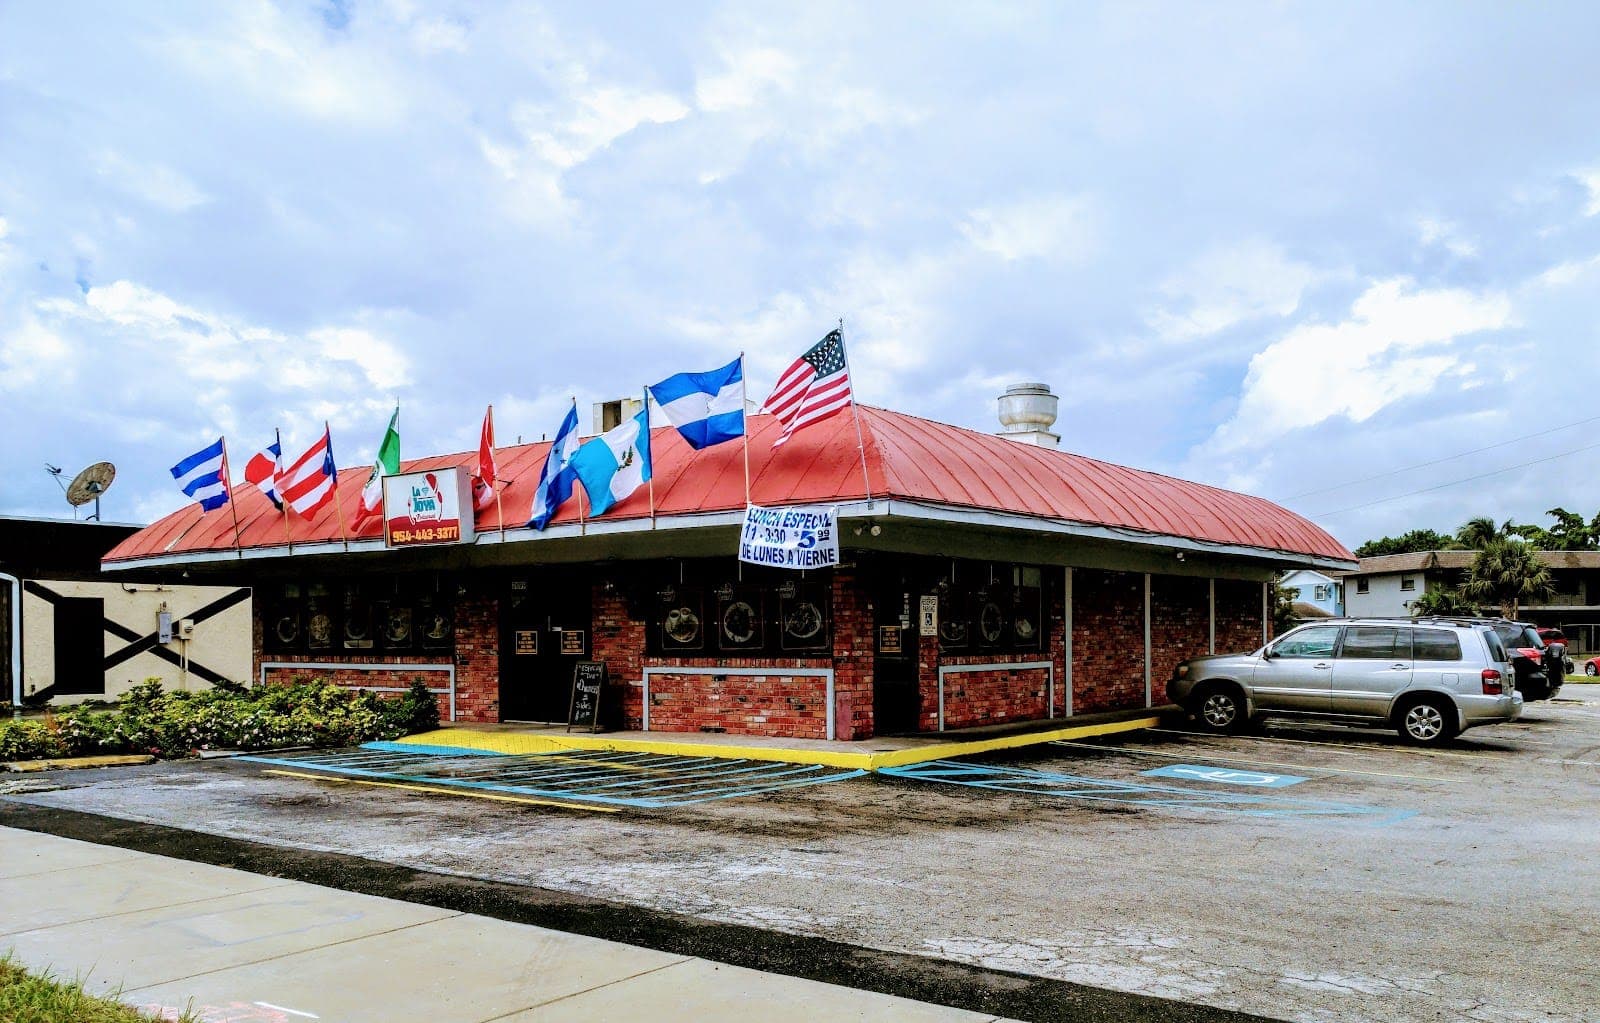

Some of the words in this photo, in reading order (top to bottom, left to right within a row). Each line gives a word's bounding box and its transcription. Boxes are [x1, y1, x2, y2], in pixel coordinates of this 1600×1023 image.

[747, 507, 783, 527] LUNCH
[745, 523, 757, 540] 11
[765, 527, 786, 544] 3:30
[742, 543, 751, 560] DE
[753, 545, 785, 564] LUNES
[787, 549, 794, 565] A
[797, 548, 835, 566] VIERNE
